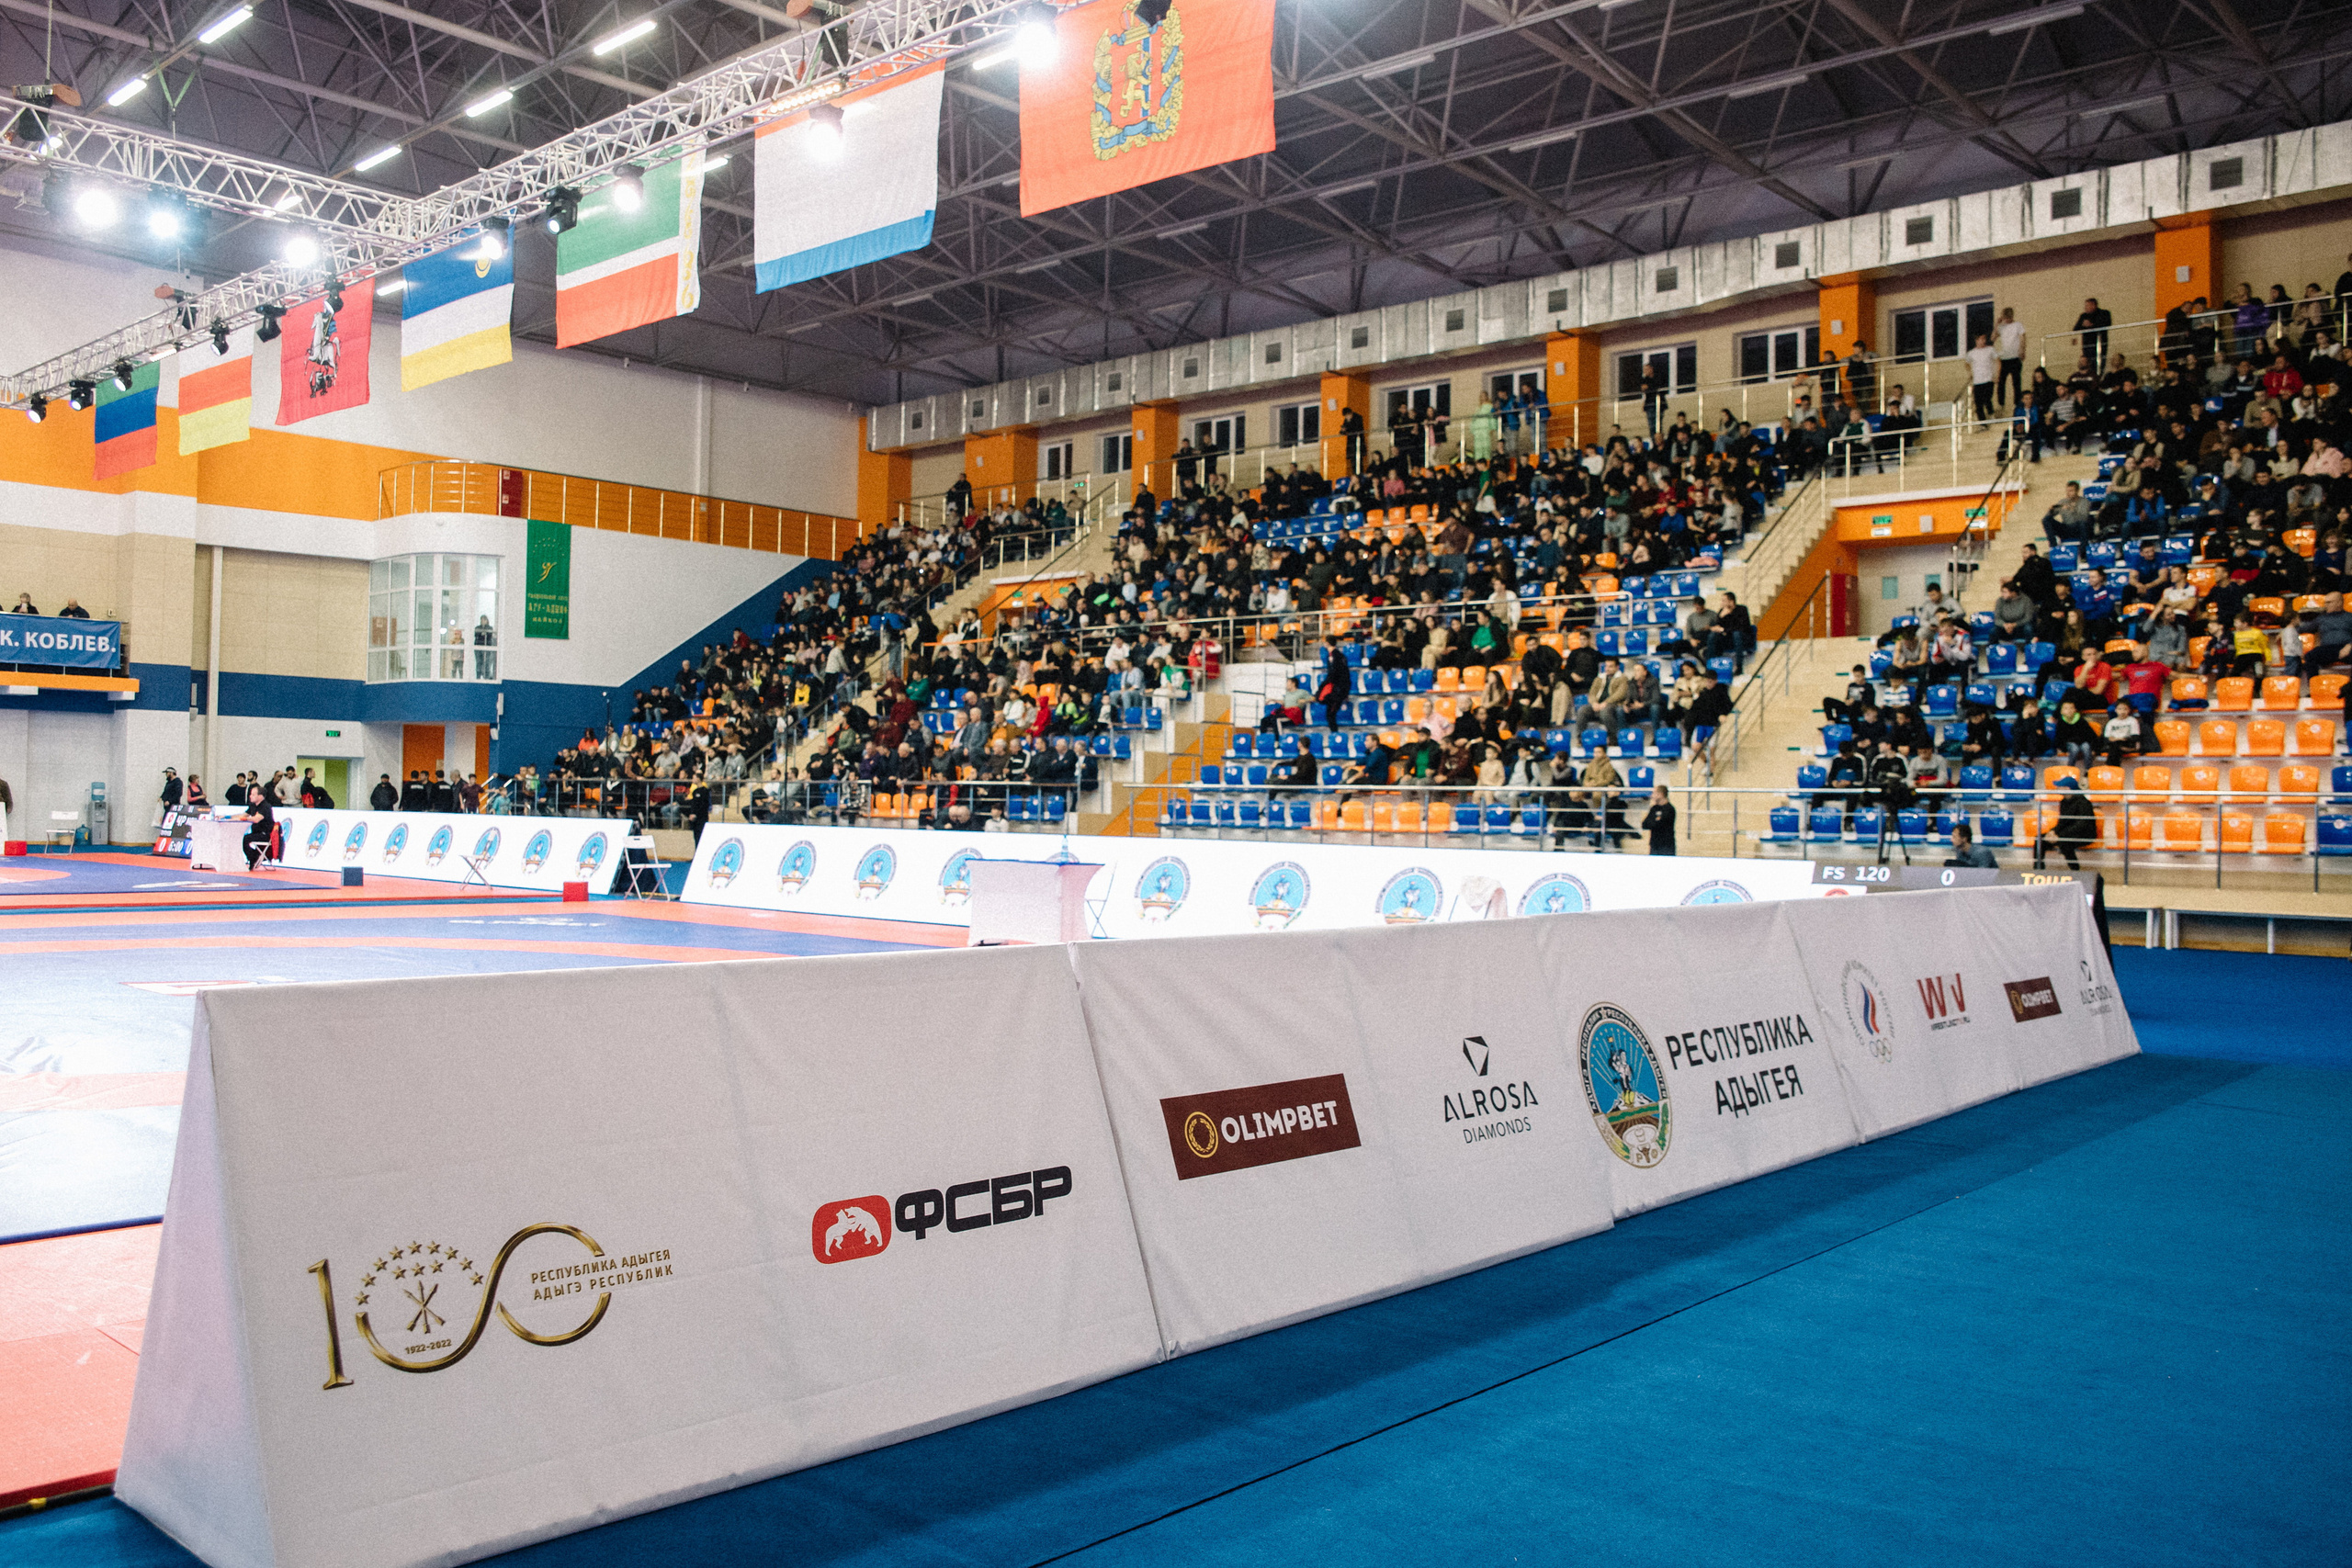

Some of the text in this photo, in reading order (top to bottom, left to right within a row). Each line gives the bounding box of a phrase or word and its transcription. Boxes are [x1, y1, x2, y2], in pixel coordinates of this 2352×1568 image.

[26, 631, 116, 653] КОБЛЕВ.
[1823, 866, 1891, 882] FS 120
[1940, 869, 1955, 886] 0
[1665, 1014, 1814, 1070] РЕСПУБЛИКА
[1444, 1080, 1539, 1123] ALROSA
[1715, 1064, 1804, 1118] АДЫГЕЯ
[1221, 1100, 1339, 1144] OLIMPBET
[1463, 1115, 1532, 1145] DIAMONDS
[895, 1165, 1072, 1241] ФСБР
[531, 1248, 671, 1284] РЕСПУБЛИКА АДЫГЕЯ
[533, 1264, 673, 1301] АДЫГЭ РЕСПУБЛИК
[404, 1338, 453, 1356] 1922-2022
